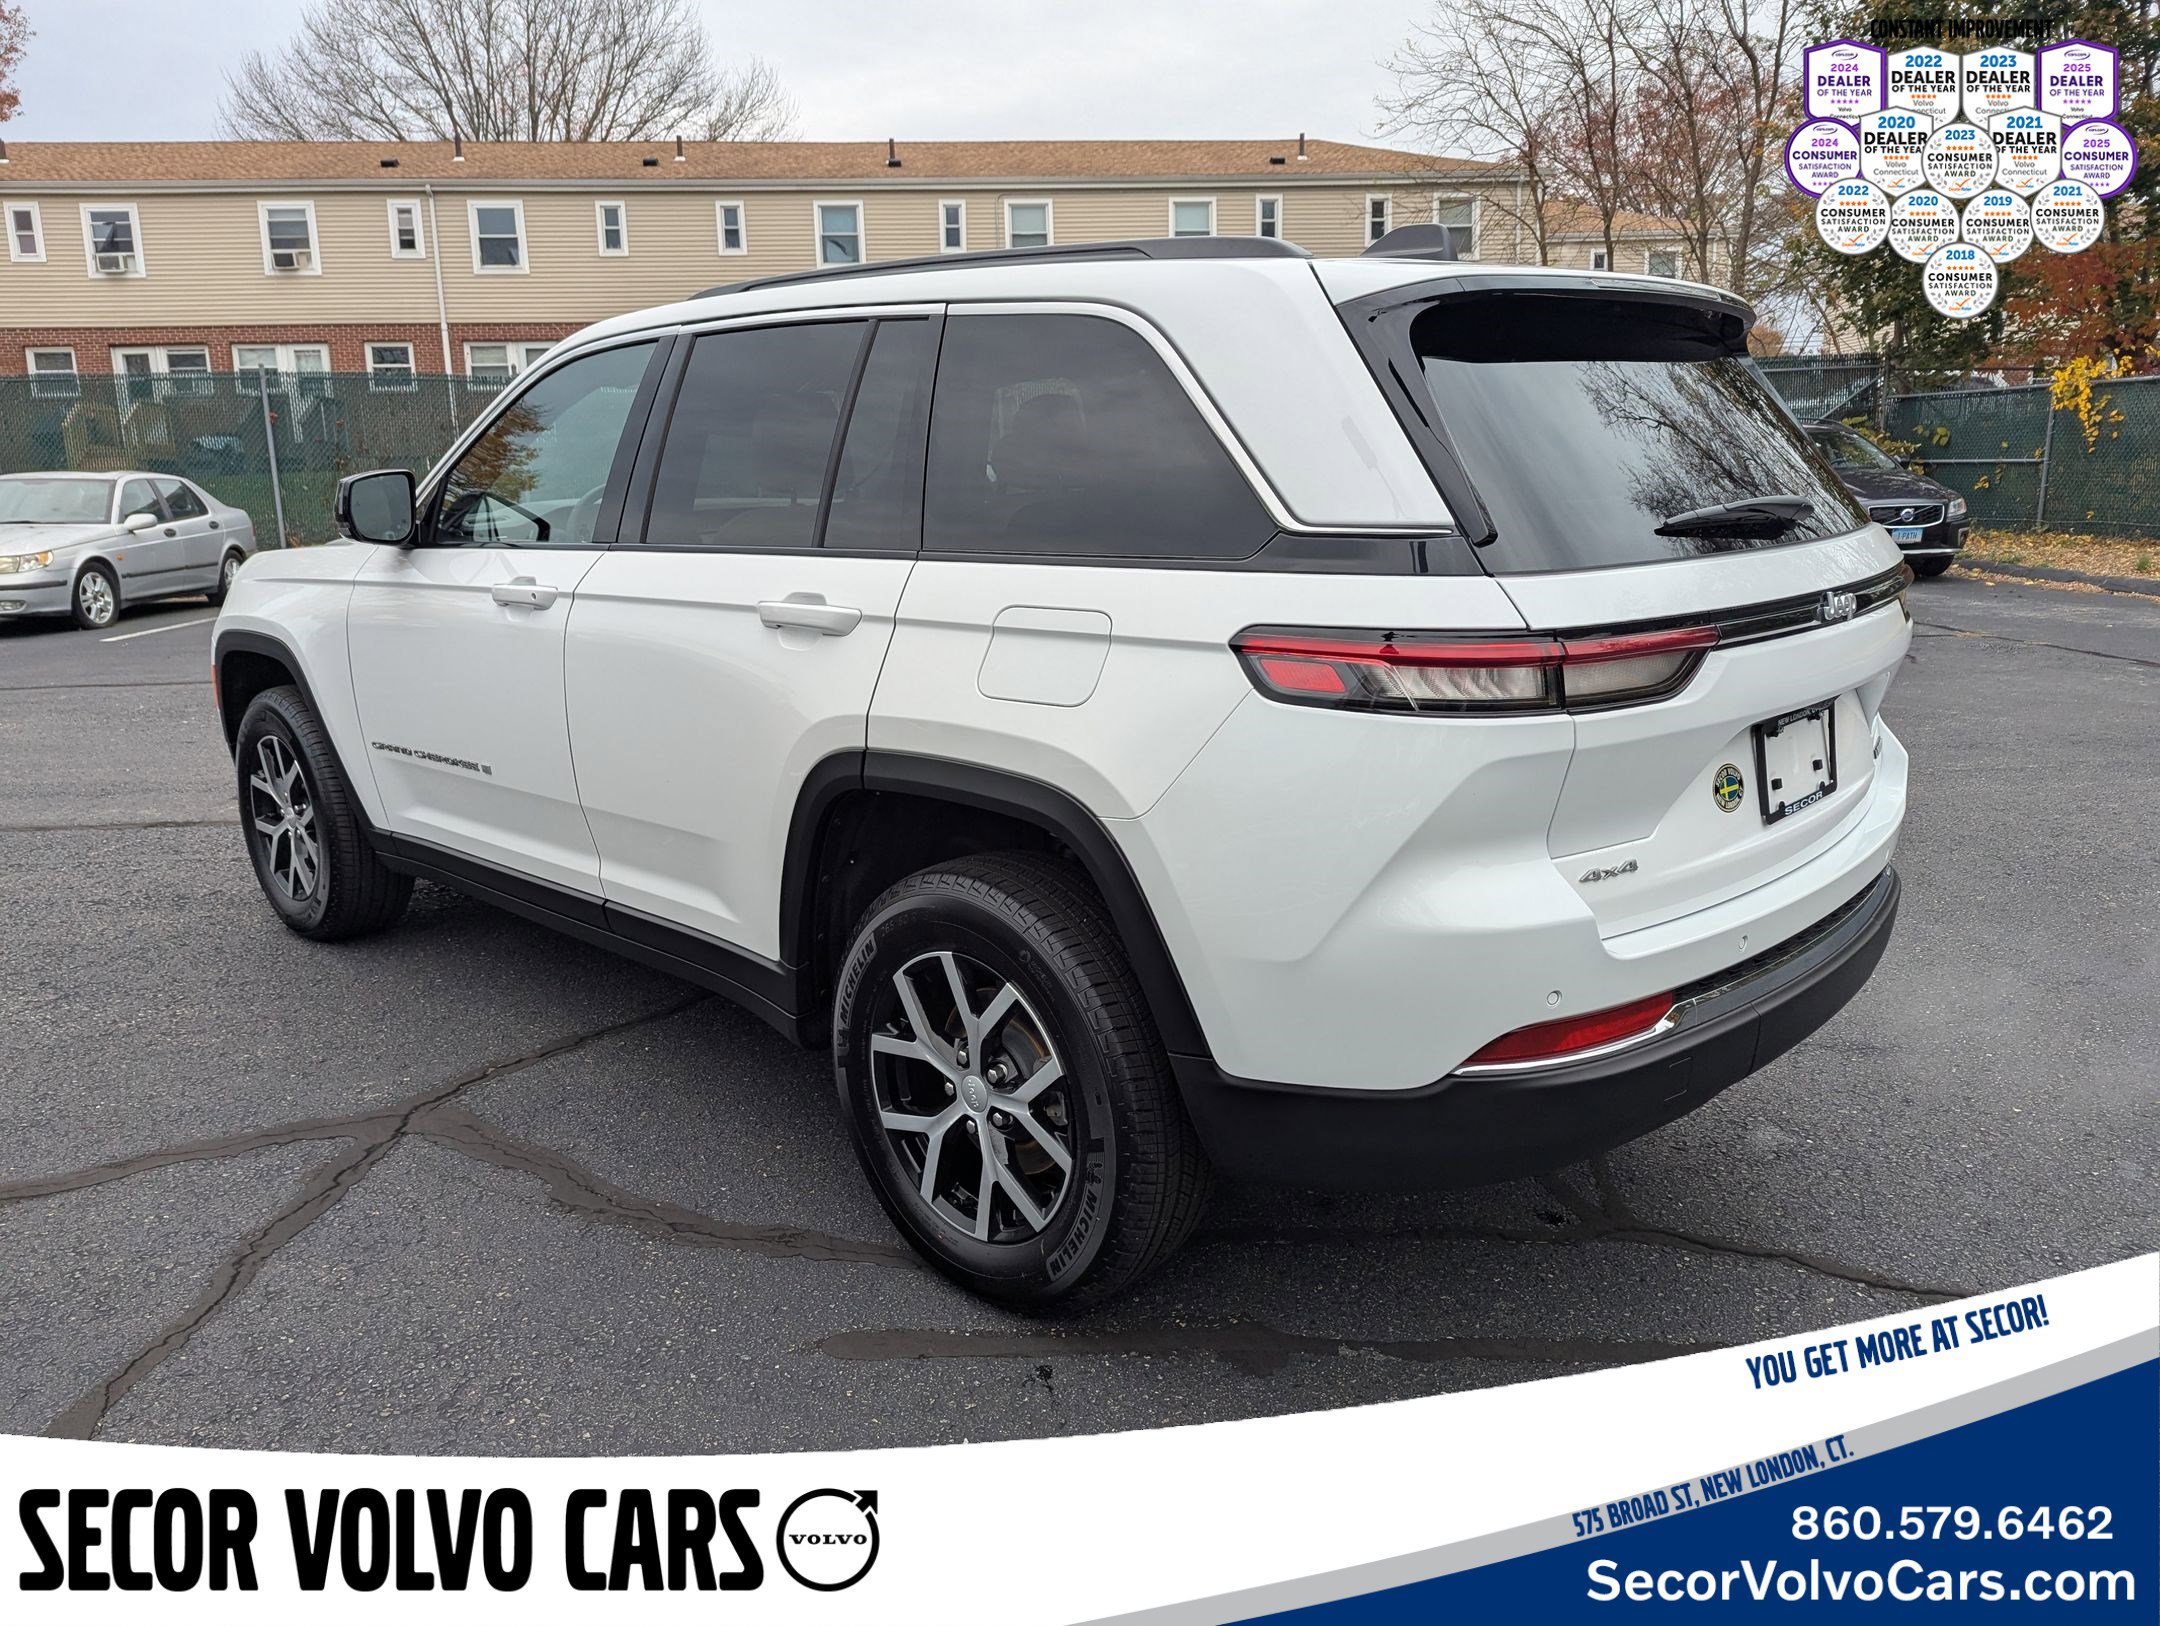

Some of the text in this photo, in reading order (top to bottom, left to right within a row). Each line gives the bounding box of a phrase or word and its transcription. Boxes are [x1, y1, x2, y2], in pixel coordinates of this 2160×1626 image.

[1784, 790, 1824, 816] SECOR
[1579, 859, 1638, 883] 4x4
[839, 939, 875, 1024] MICHELIN
[1049, 1188, 1098, 1276] MICHELIN
